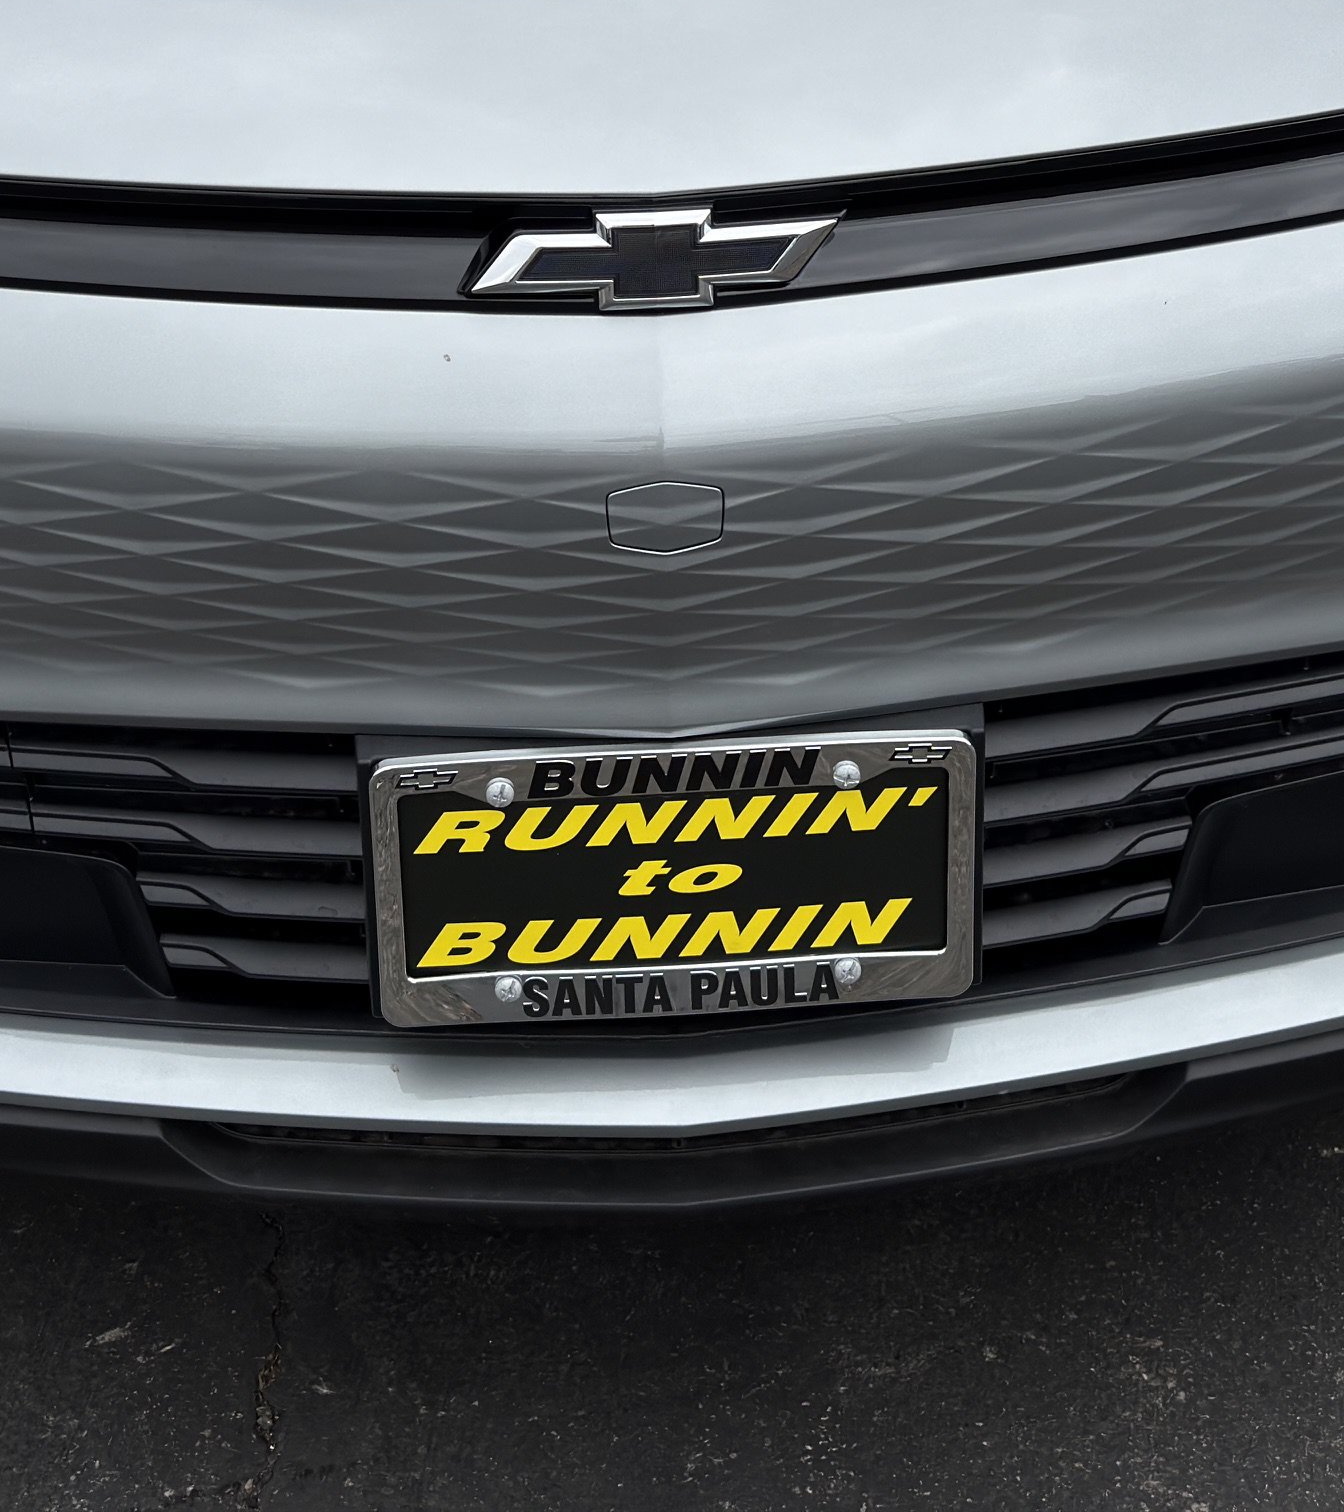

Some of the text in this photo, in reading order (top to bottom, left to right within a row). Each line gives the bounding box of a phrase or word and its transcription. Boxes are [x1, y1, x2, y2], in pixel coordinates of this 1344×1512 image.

[527, 746, 823, 799] BUNNIN
[413, 785, 939, 855] RUNNIN'
[617, 859, 744, 897] to
[416, 897, 913, 968] BUNNIN
[522, 961, 840, 1019] SANTA PAULA
